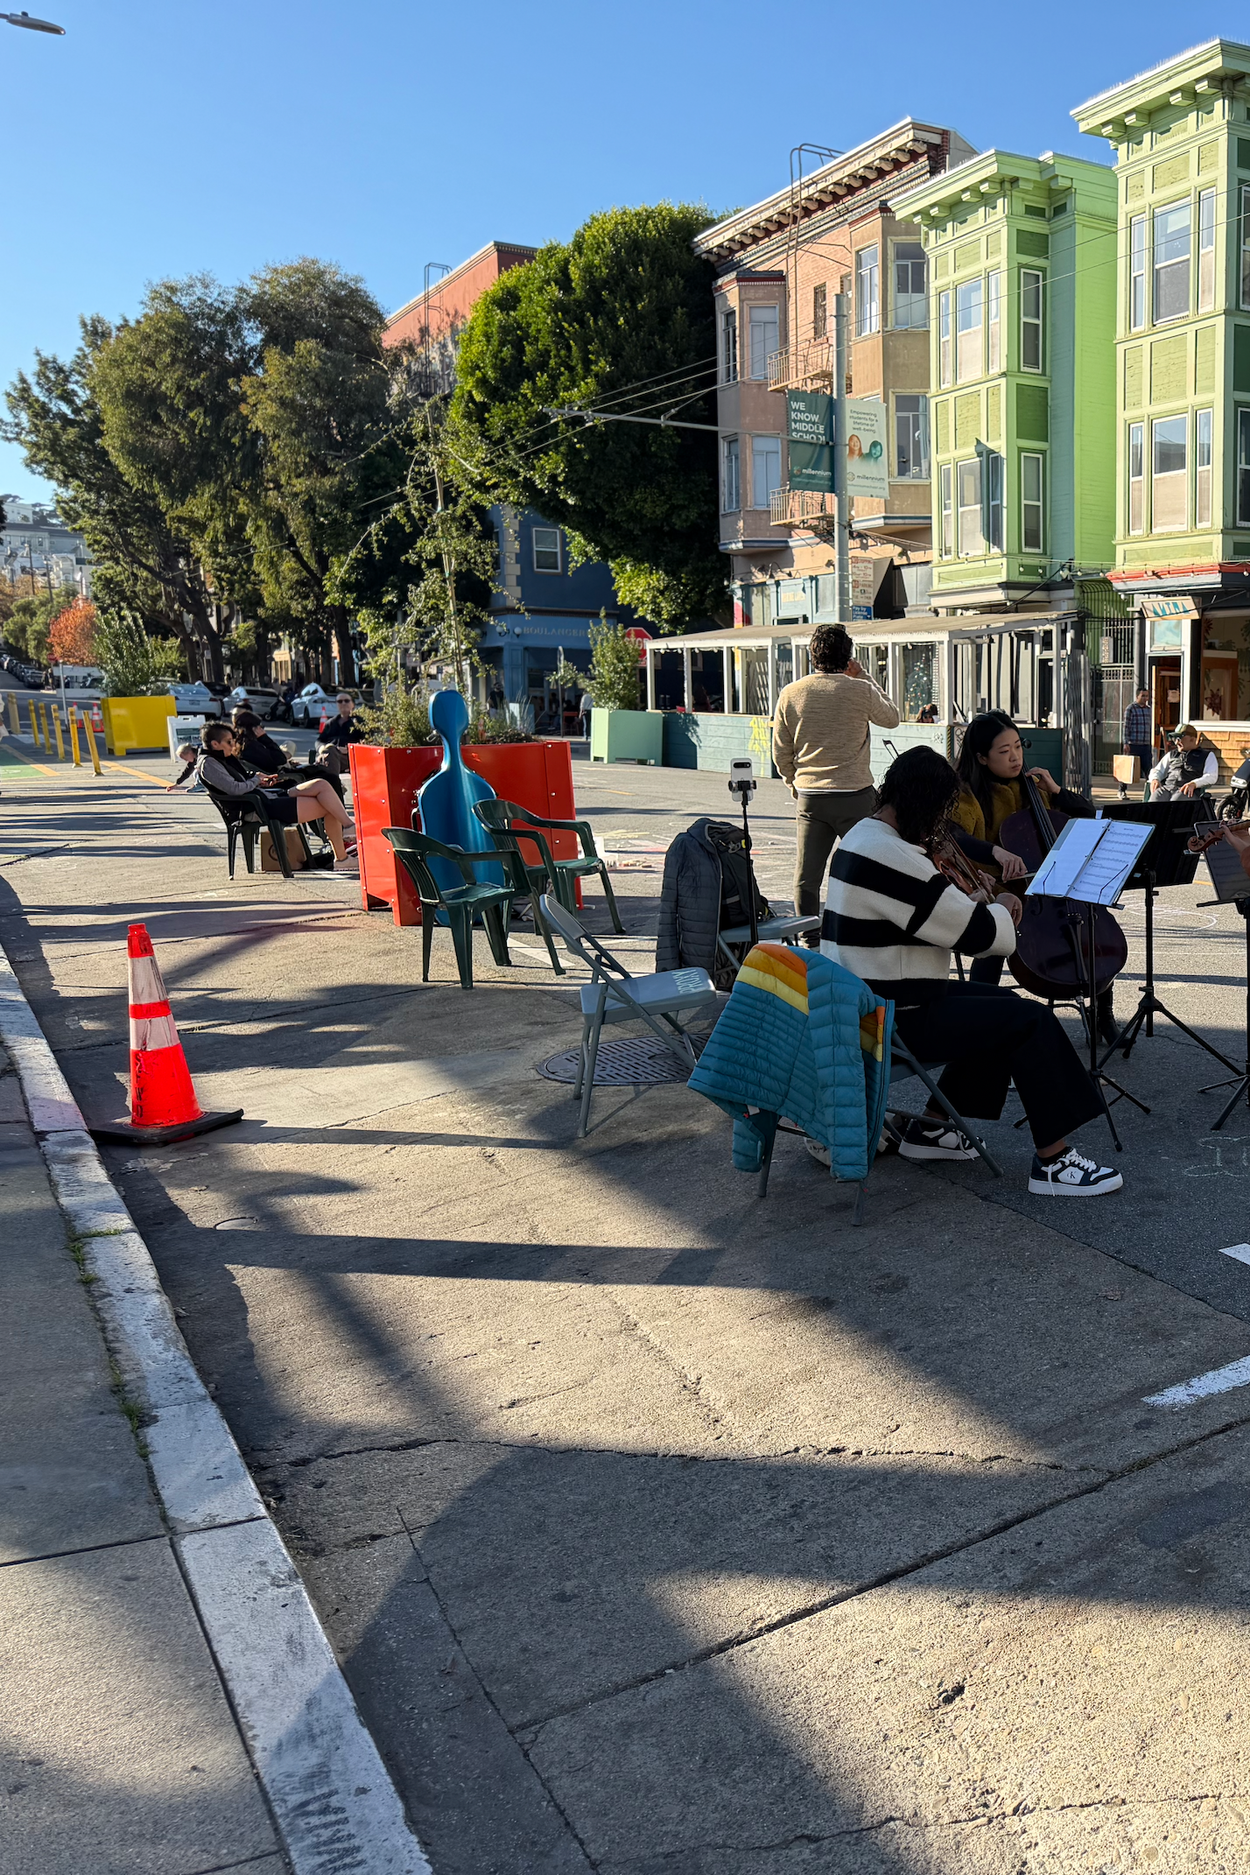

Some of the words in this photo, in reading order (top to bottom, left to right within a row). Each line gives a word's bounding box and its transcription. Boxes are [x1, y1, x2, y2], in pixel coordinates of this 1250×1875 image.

[790, 401, 806, 411] WE
[791, 411, 819, 422] KNOW
[791, 421, 825, 434] MIDDLE
